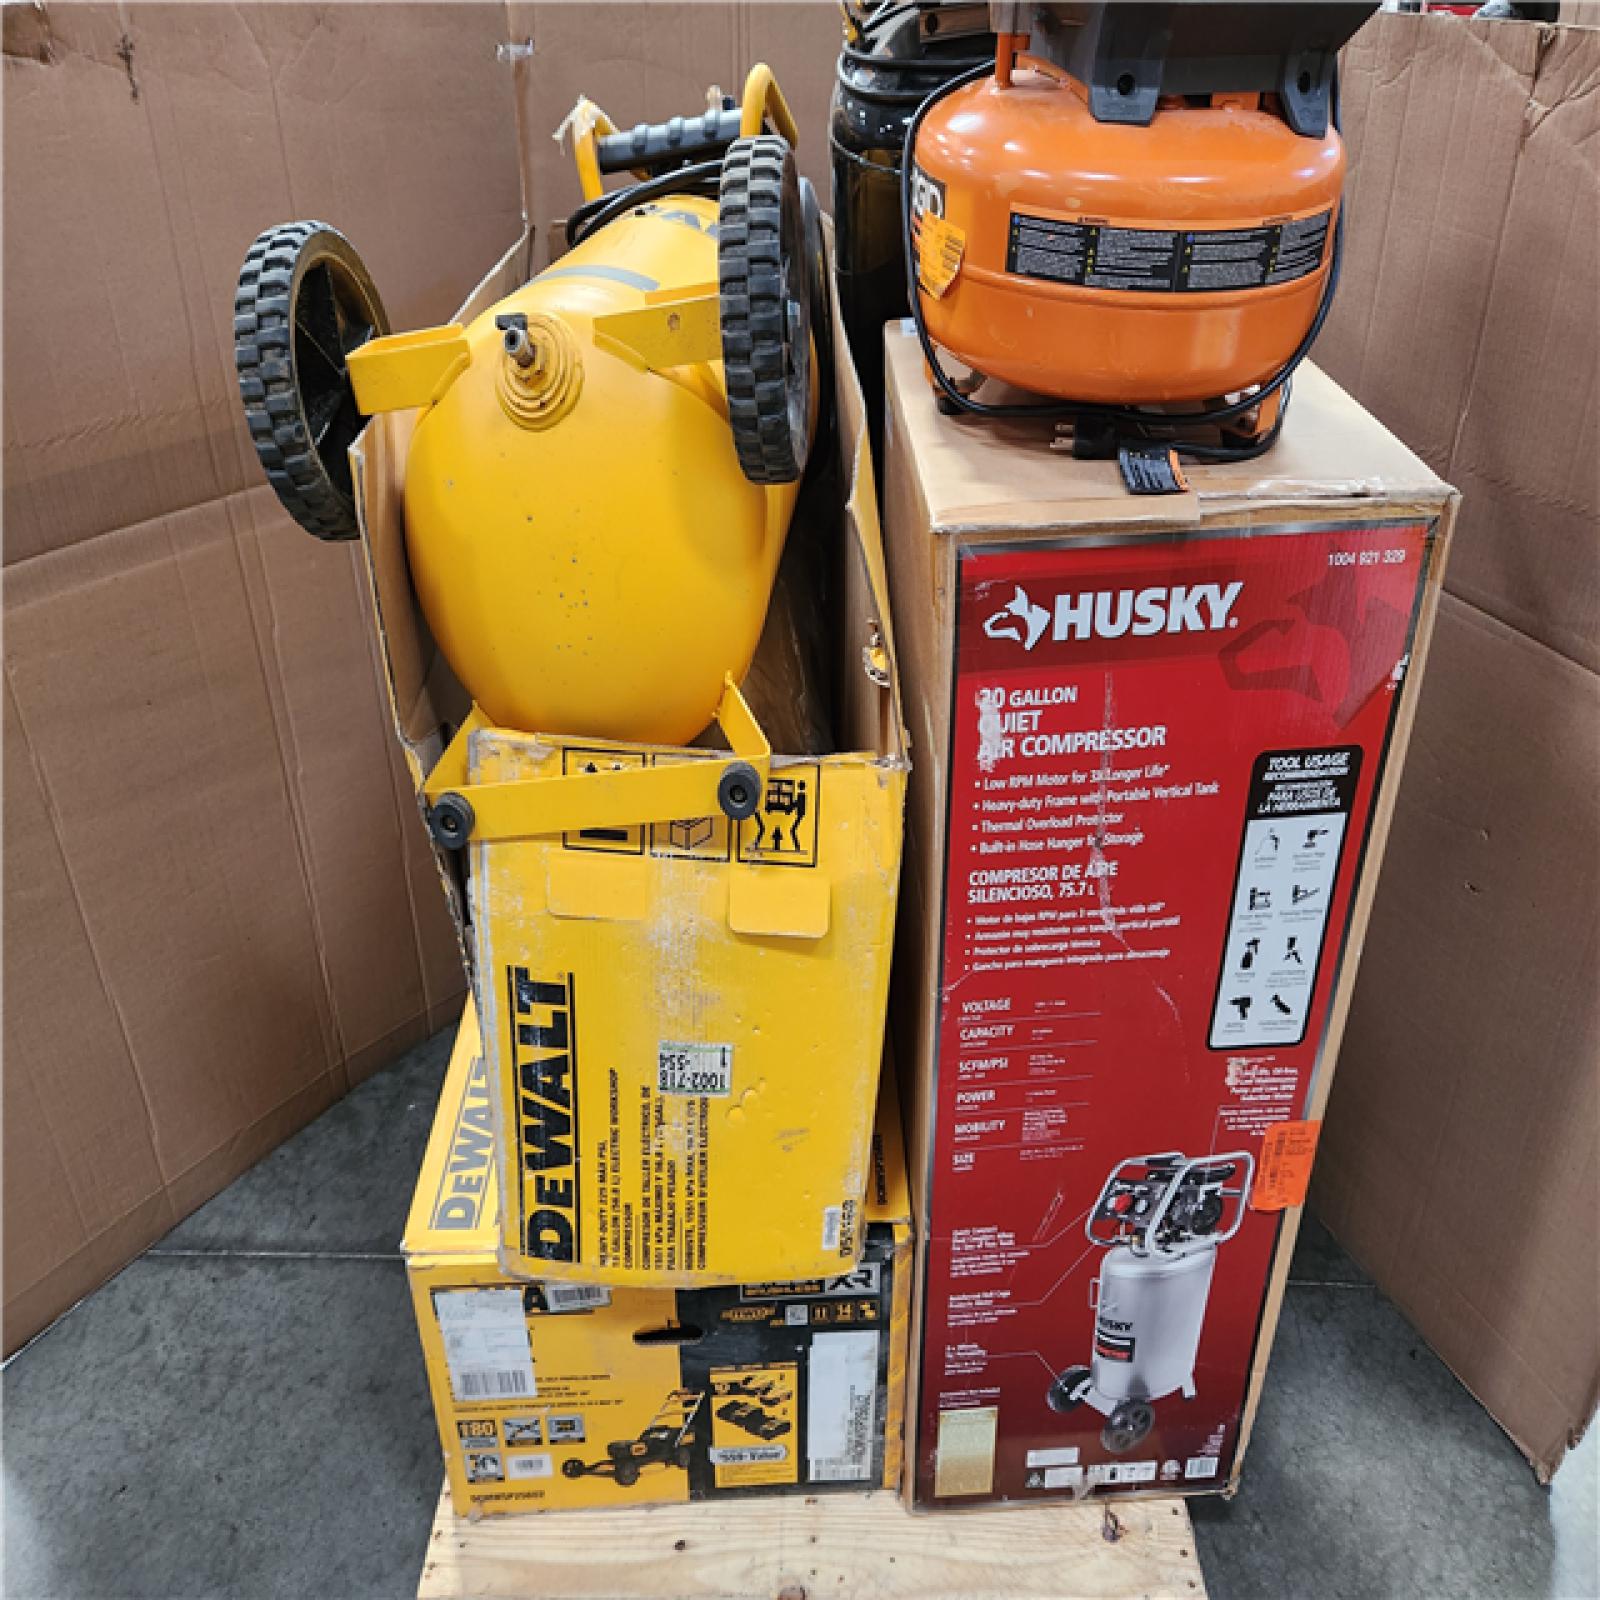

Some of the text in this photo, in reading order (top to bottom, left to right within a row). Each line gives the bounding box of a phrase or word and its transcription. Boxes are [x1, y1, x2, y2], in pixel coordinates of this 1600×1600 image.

[1052, 582, 1243, 641] HUSKY
[1009, 686, 1078, 706] GALLON
[1020, 726, 1167, 757] COMPRESSOR
[1269, 751, 1351, 771] TOOL USAGE
[984, 777, 1006, 791] Low
[1009, 774, 1033, 789] RPM
[1036, 772, 1069, 786] Motor
[1071, 771, 1087, 784] for
[1103, 767, 1142, 782] Longer
[982, 781, 1220, 813] Heavy-duty Frame with Portable Vertical Tank
[982, 819, 1024, 833] Thermal
[1025, 815, 1074, 830] Overload
[979, 840, 1016, 856] Built-in
[1019, 838, 1045, 851] Hose
[1047, 836, 1085, 852] Hanger
[1103, 830, 1144, 846] Storage
[968, 860, 1119, 887] COMPRESOR DE AIRE
[967, 885, 1054, 904] SILENCIOSO,
[962, 997, 1011, 1013] VOLTAGE
[960, 1024, 1015, 1041] CAPACITY
[609, 1068, 619, 1127] WORKSHOP
[641, 1086, 650, 1099] DE
[956, 1090, 995, 1104] POWER
[515, 967, 573, 1262] DEWALT
[955, 1119, 1005, 1135] MOBILITY
[610, 1128, 620, 1173] ELECTRIC
[952, 1152, 975, 1165] SIZE
[641, 1159, 650, 1193] TALLER
[642, 1196, 650, 1208] DE
[667, 1160, 675, 1270] PARA TRABAJO PESADO
[611, 1215, 620, 1253] GALLON
[623, 1203, 632, 1270] COMPRESSOR
[642, 1212, 650, 1270] COMPRESOR
[698, 1202, 707, 1270] COMPRESSEUR
[460, 1421, 494, 1437] 180
